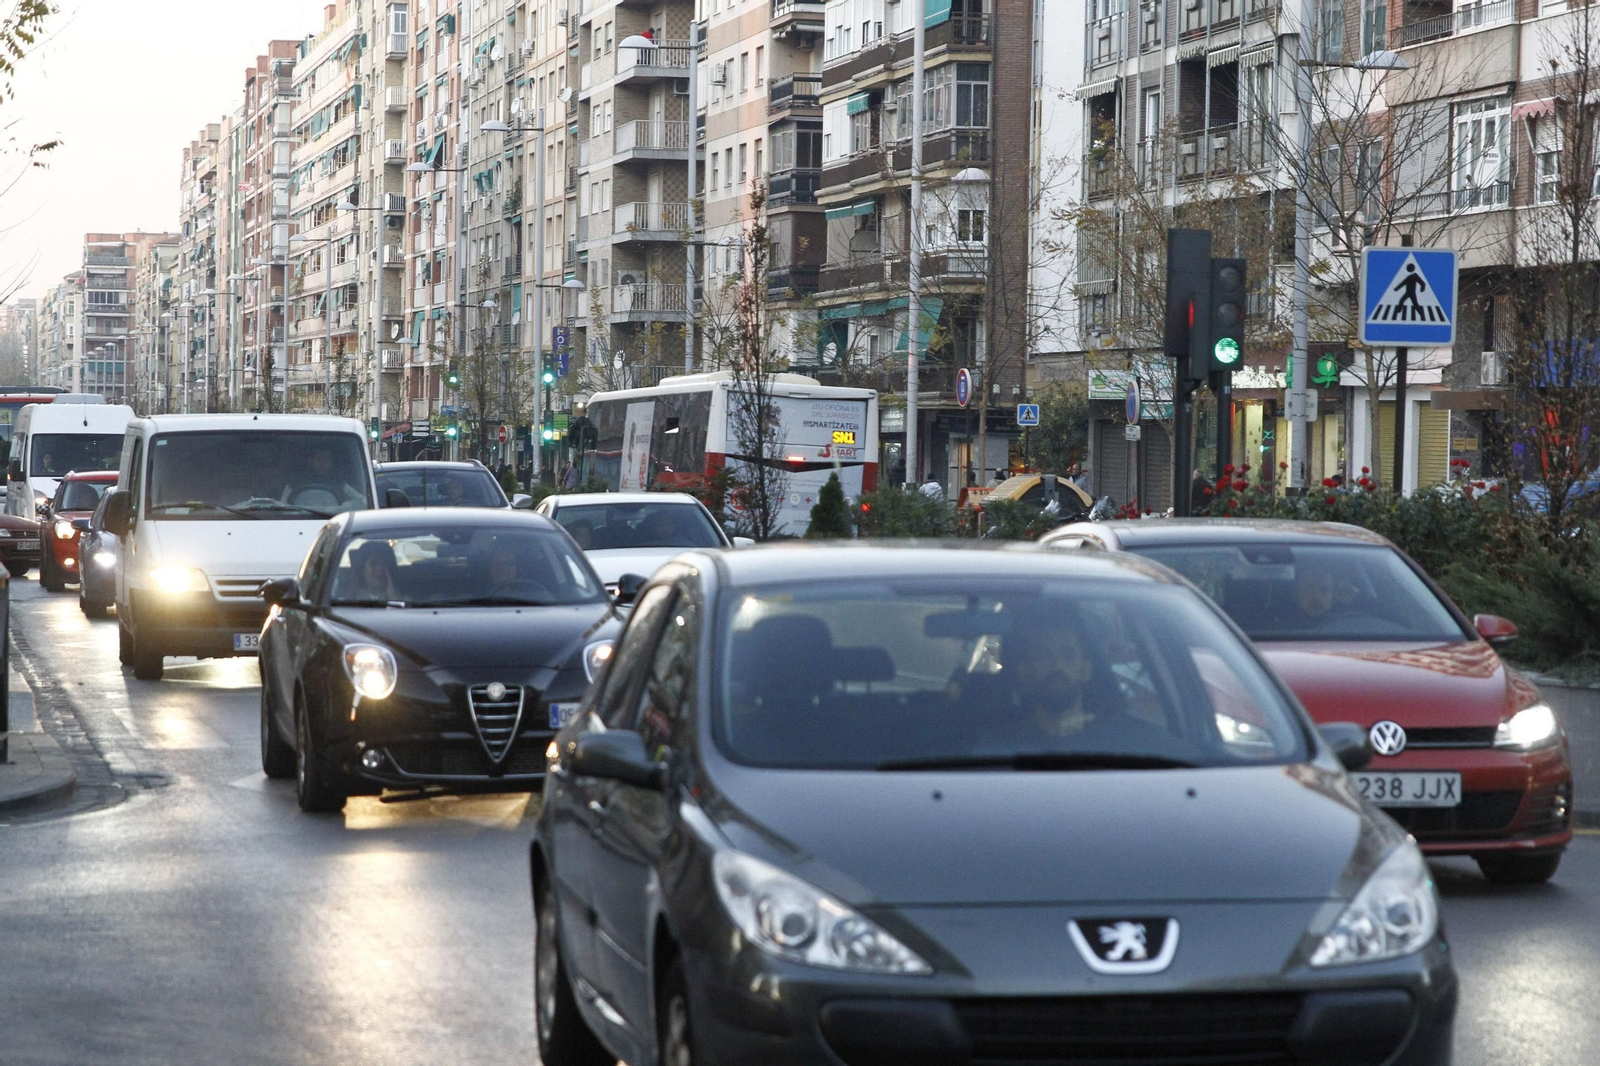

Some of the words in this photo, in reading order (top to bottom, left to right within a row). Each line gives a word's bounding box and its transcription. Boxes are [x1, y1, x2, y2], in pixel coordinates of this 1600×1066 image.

[832, 431, 855, 444] SN1
[244, 635, 259, 647] 33
[1413, 777, 1456, 799] JJX
